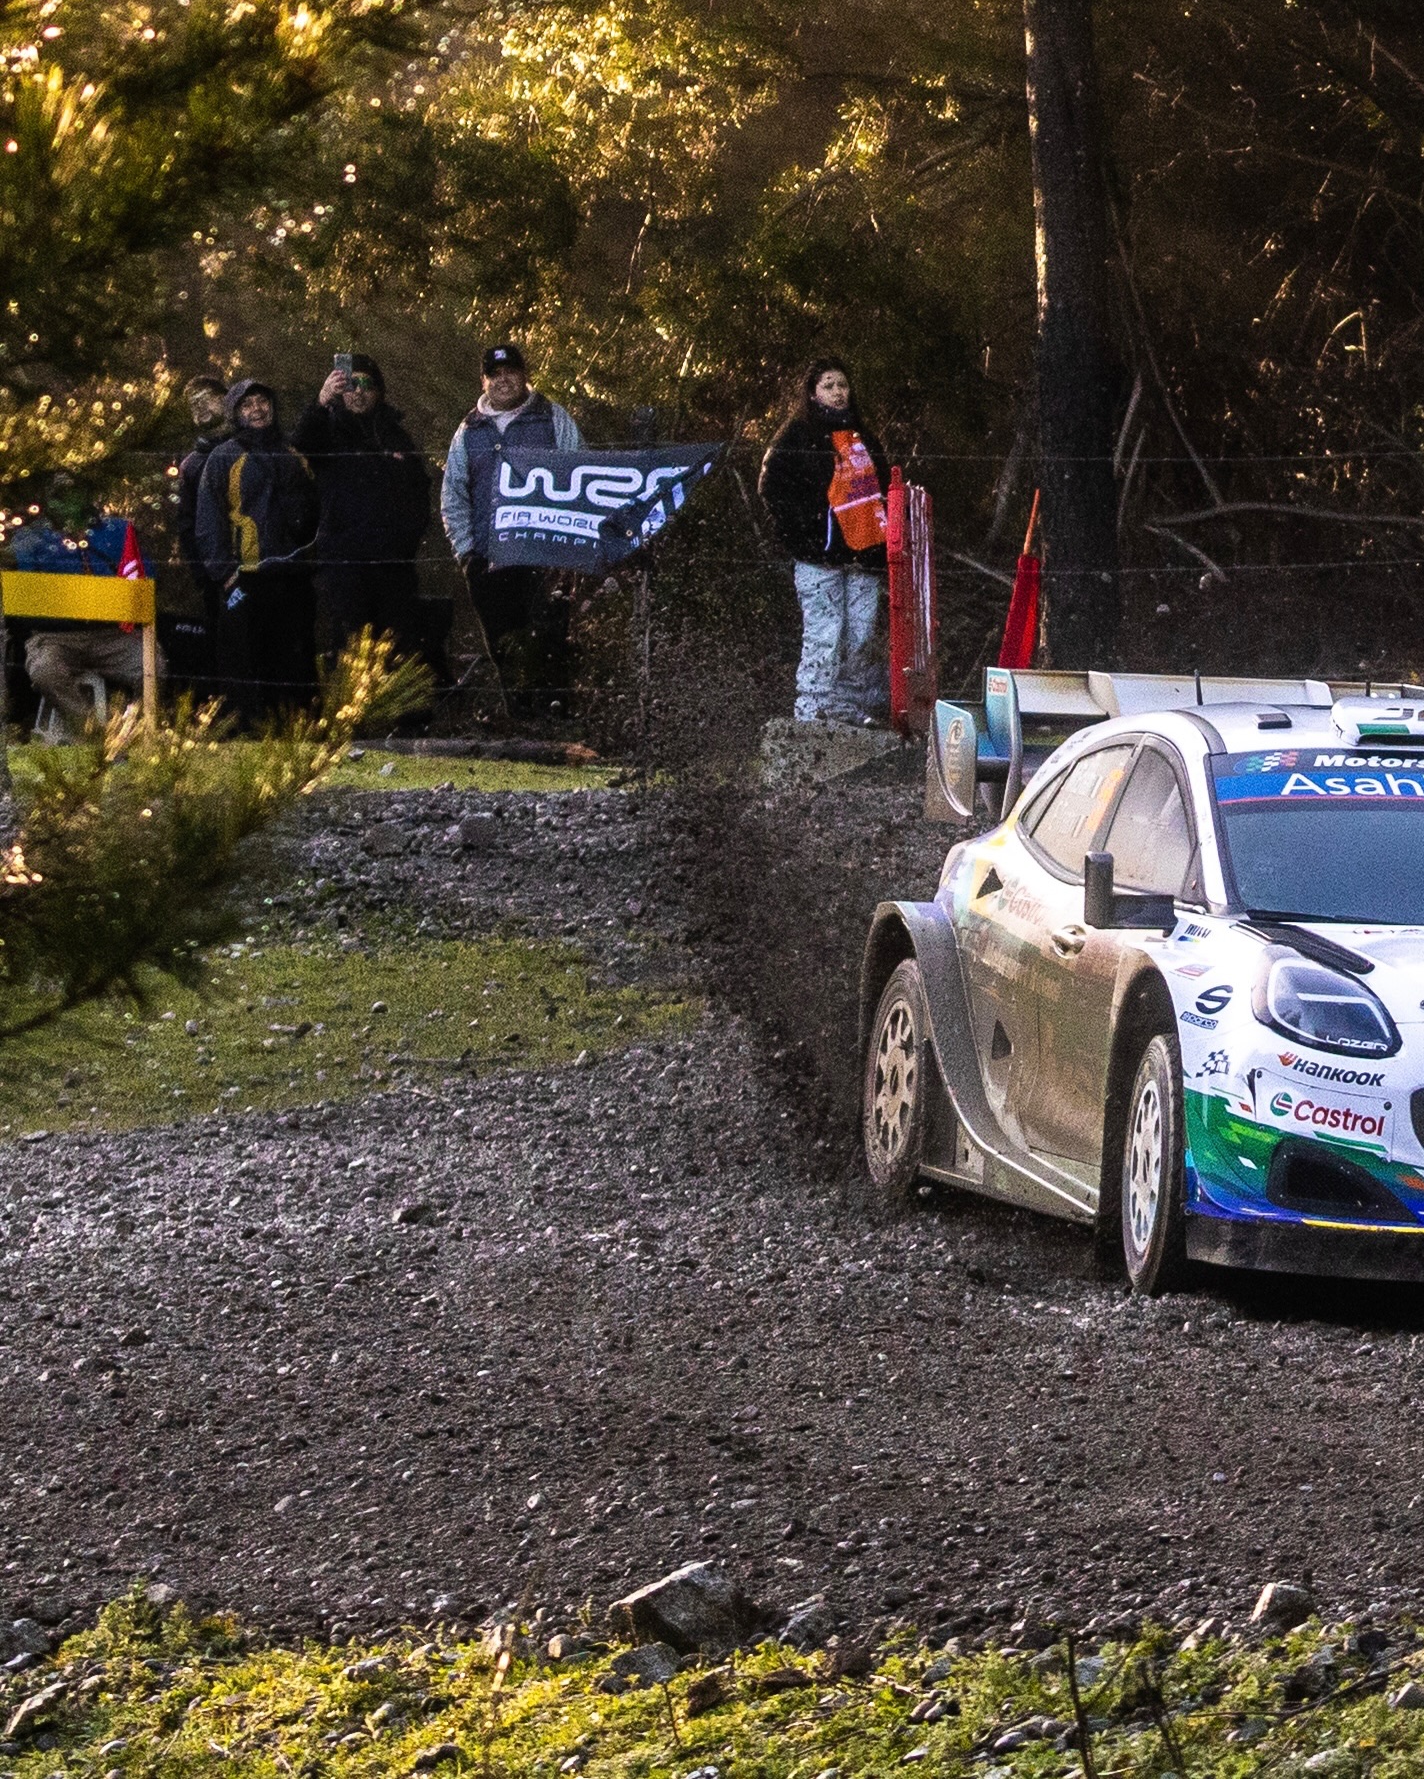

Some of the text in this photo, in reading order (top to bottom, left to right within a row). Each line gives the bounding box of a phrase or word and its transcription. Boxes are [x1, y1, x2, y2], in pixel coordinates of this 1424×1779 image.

[500, 511, 599, 531] FIA WORL
[498, 532, 597, 548] CHAMPI
[1294, 1100, 1385, 1136] Castrol
